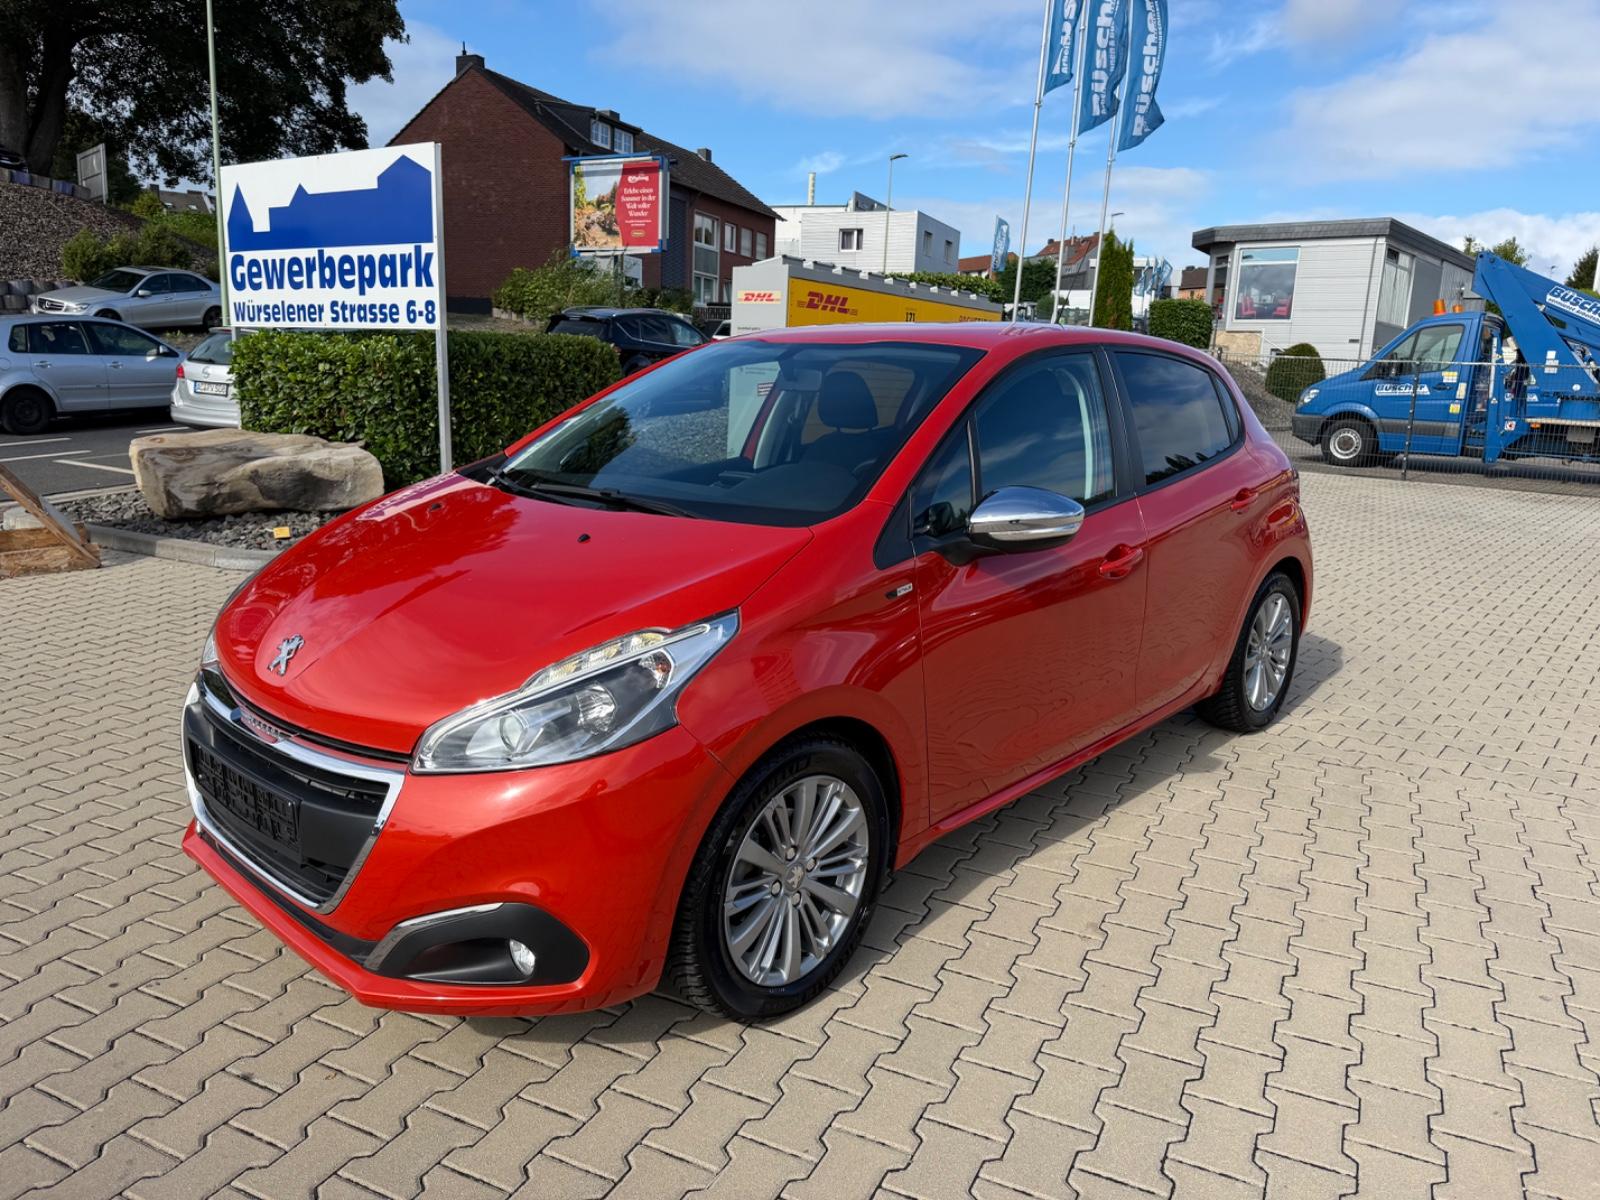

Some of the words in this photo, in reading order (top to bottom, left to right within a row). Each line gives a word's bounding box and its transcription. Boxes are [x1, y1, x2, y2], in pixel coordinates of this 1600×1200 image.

[230, 244, 434, 296] Gewerbepark
[744, 292, 775, 302] DHL
[805, 290, 850, 314] DHL
[233, 300, 324, 322] Würselener
[330, 300, 400, 323] Strasse
[406, 300, 436, 324] 6-8
